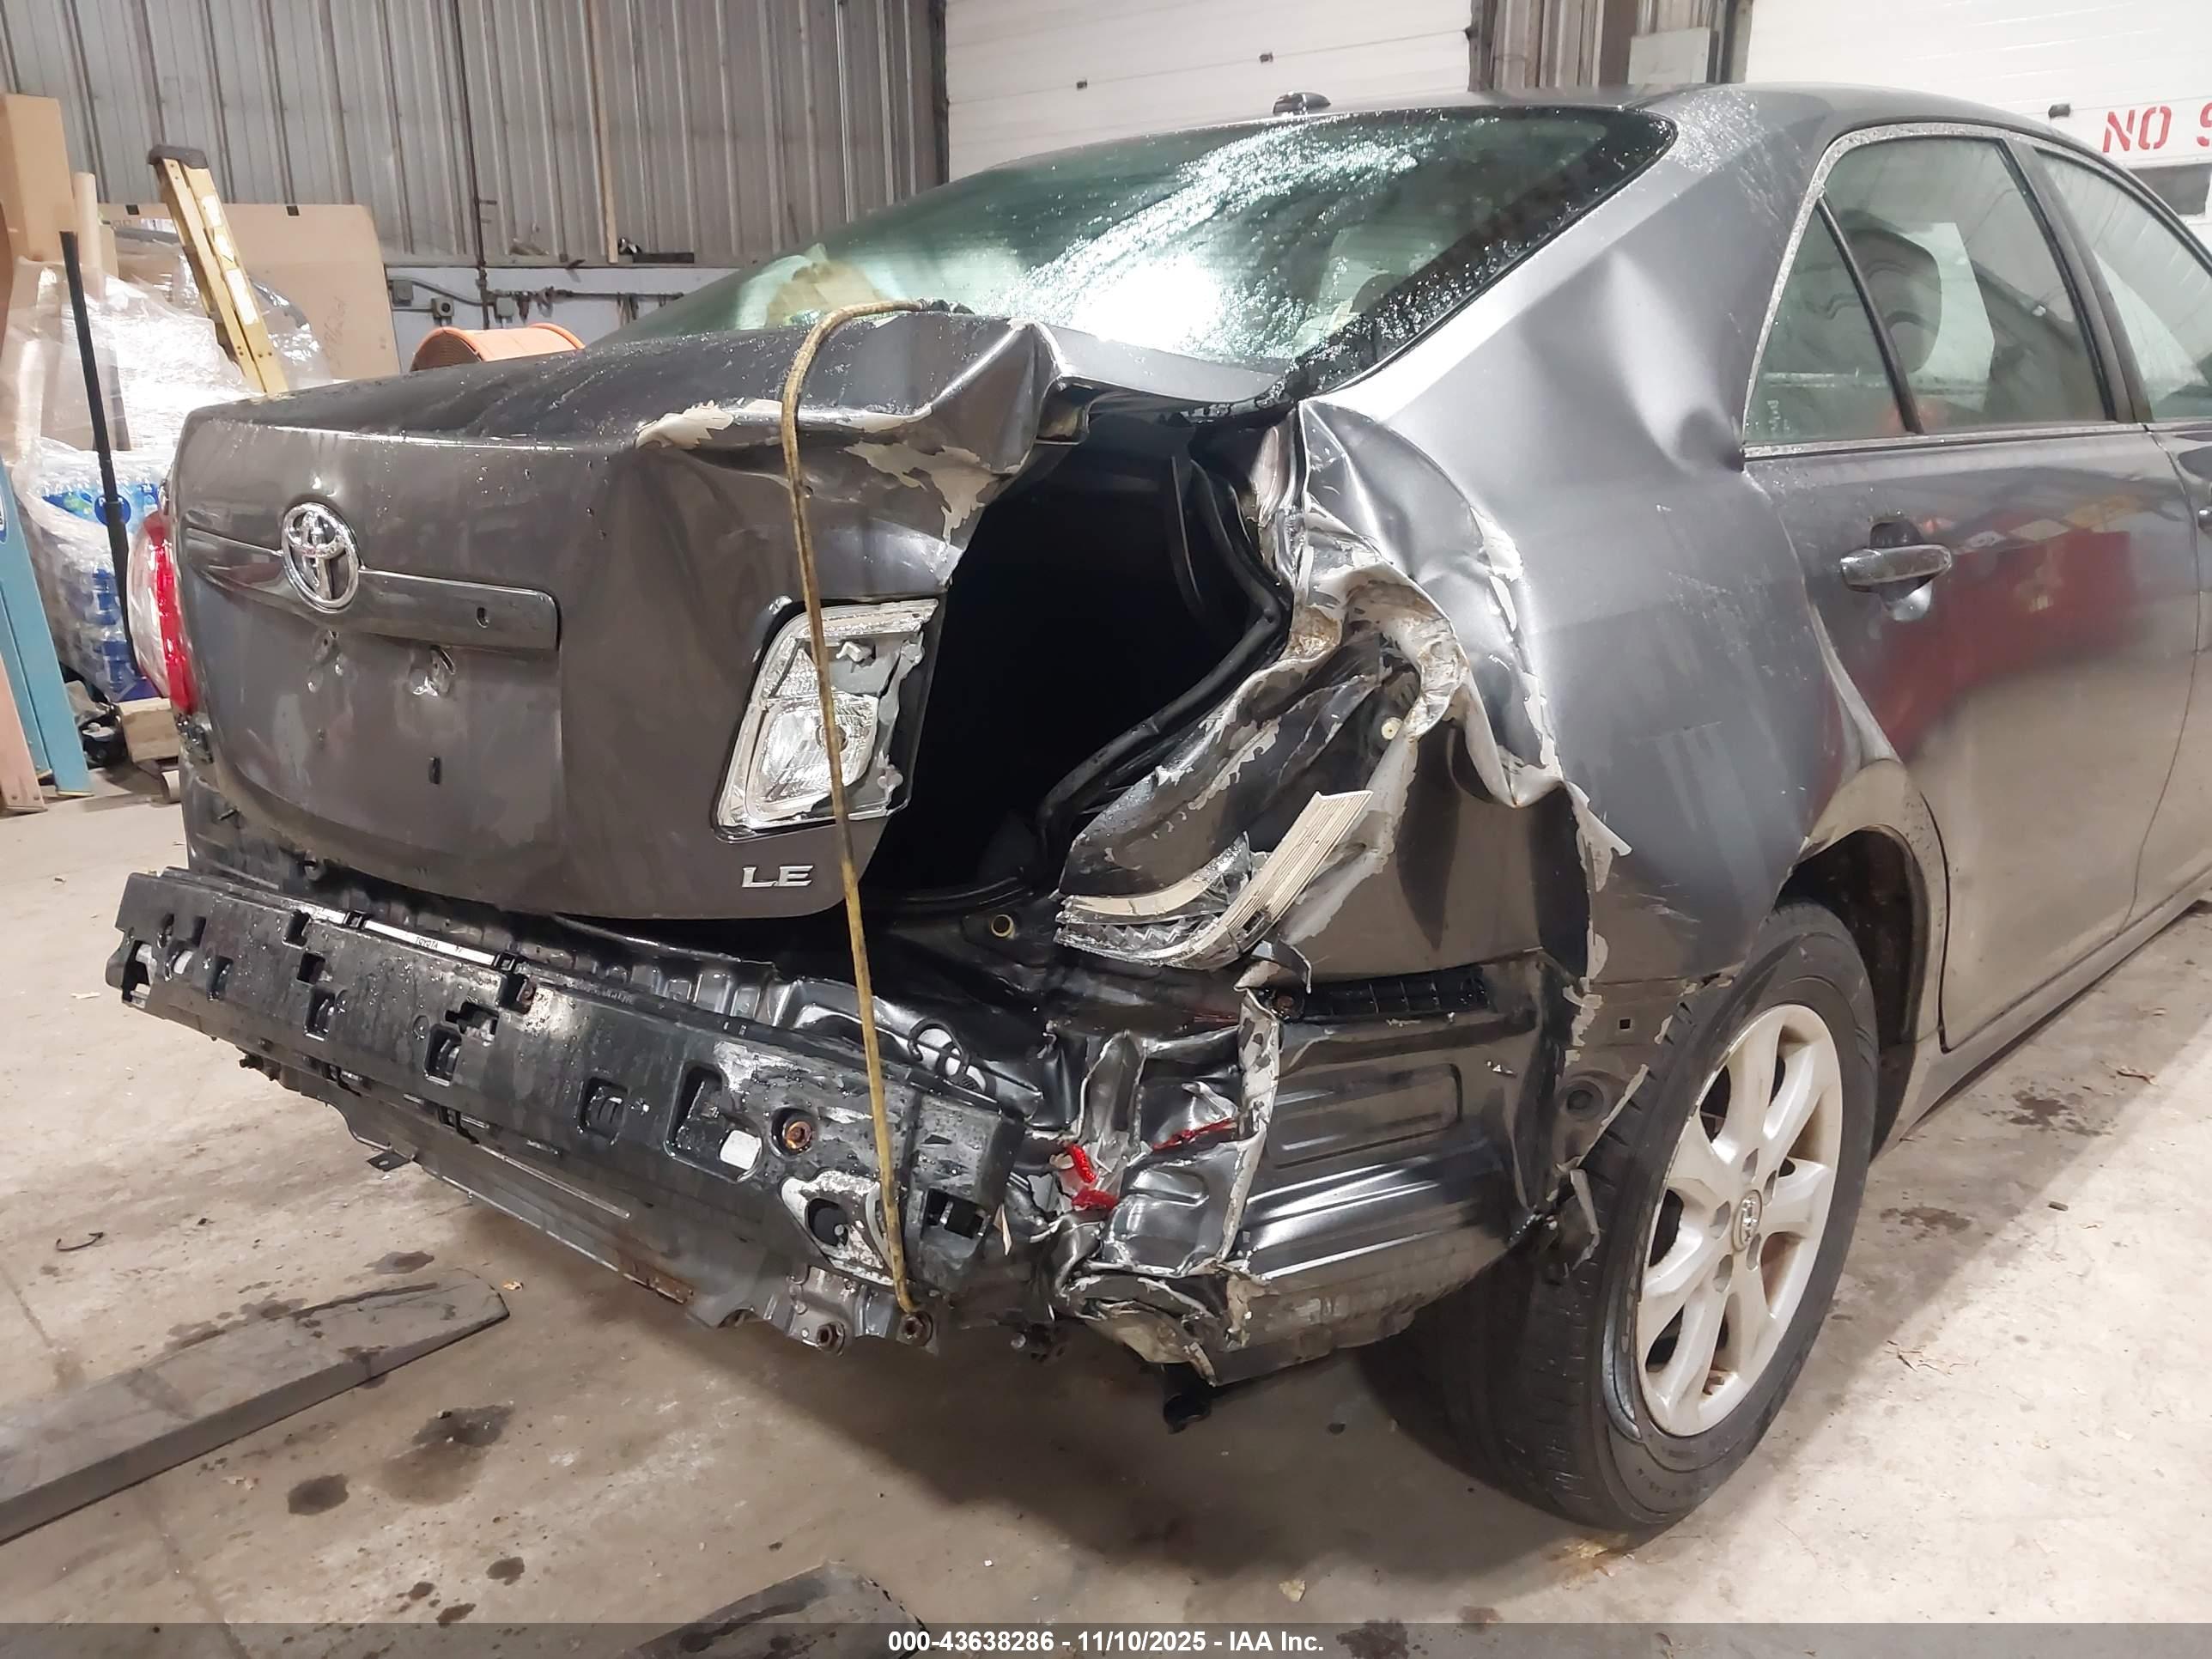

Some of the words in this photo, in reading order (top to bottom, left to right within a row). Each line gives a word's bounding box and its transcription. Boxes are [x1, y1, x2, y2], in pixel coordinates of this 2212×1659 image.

[2103, 106, 2172, 153] NO
[742, 865, 813, 888] LE
[415, 936, 440, 950] TOYOTA
